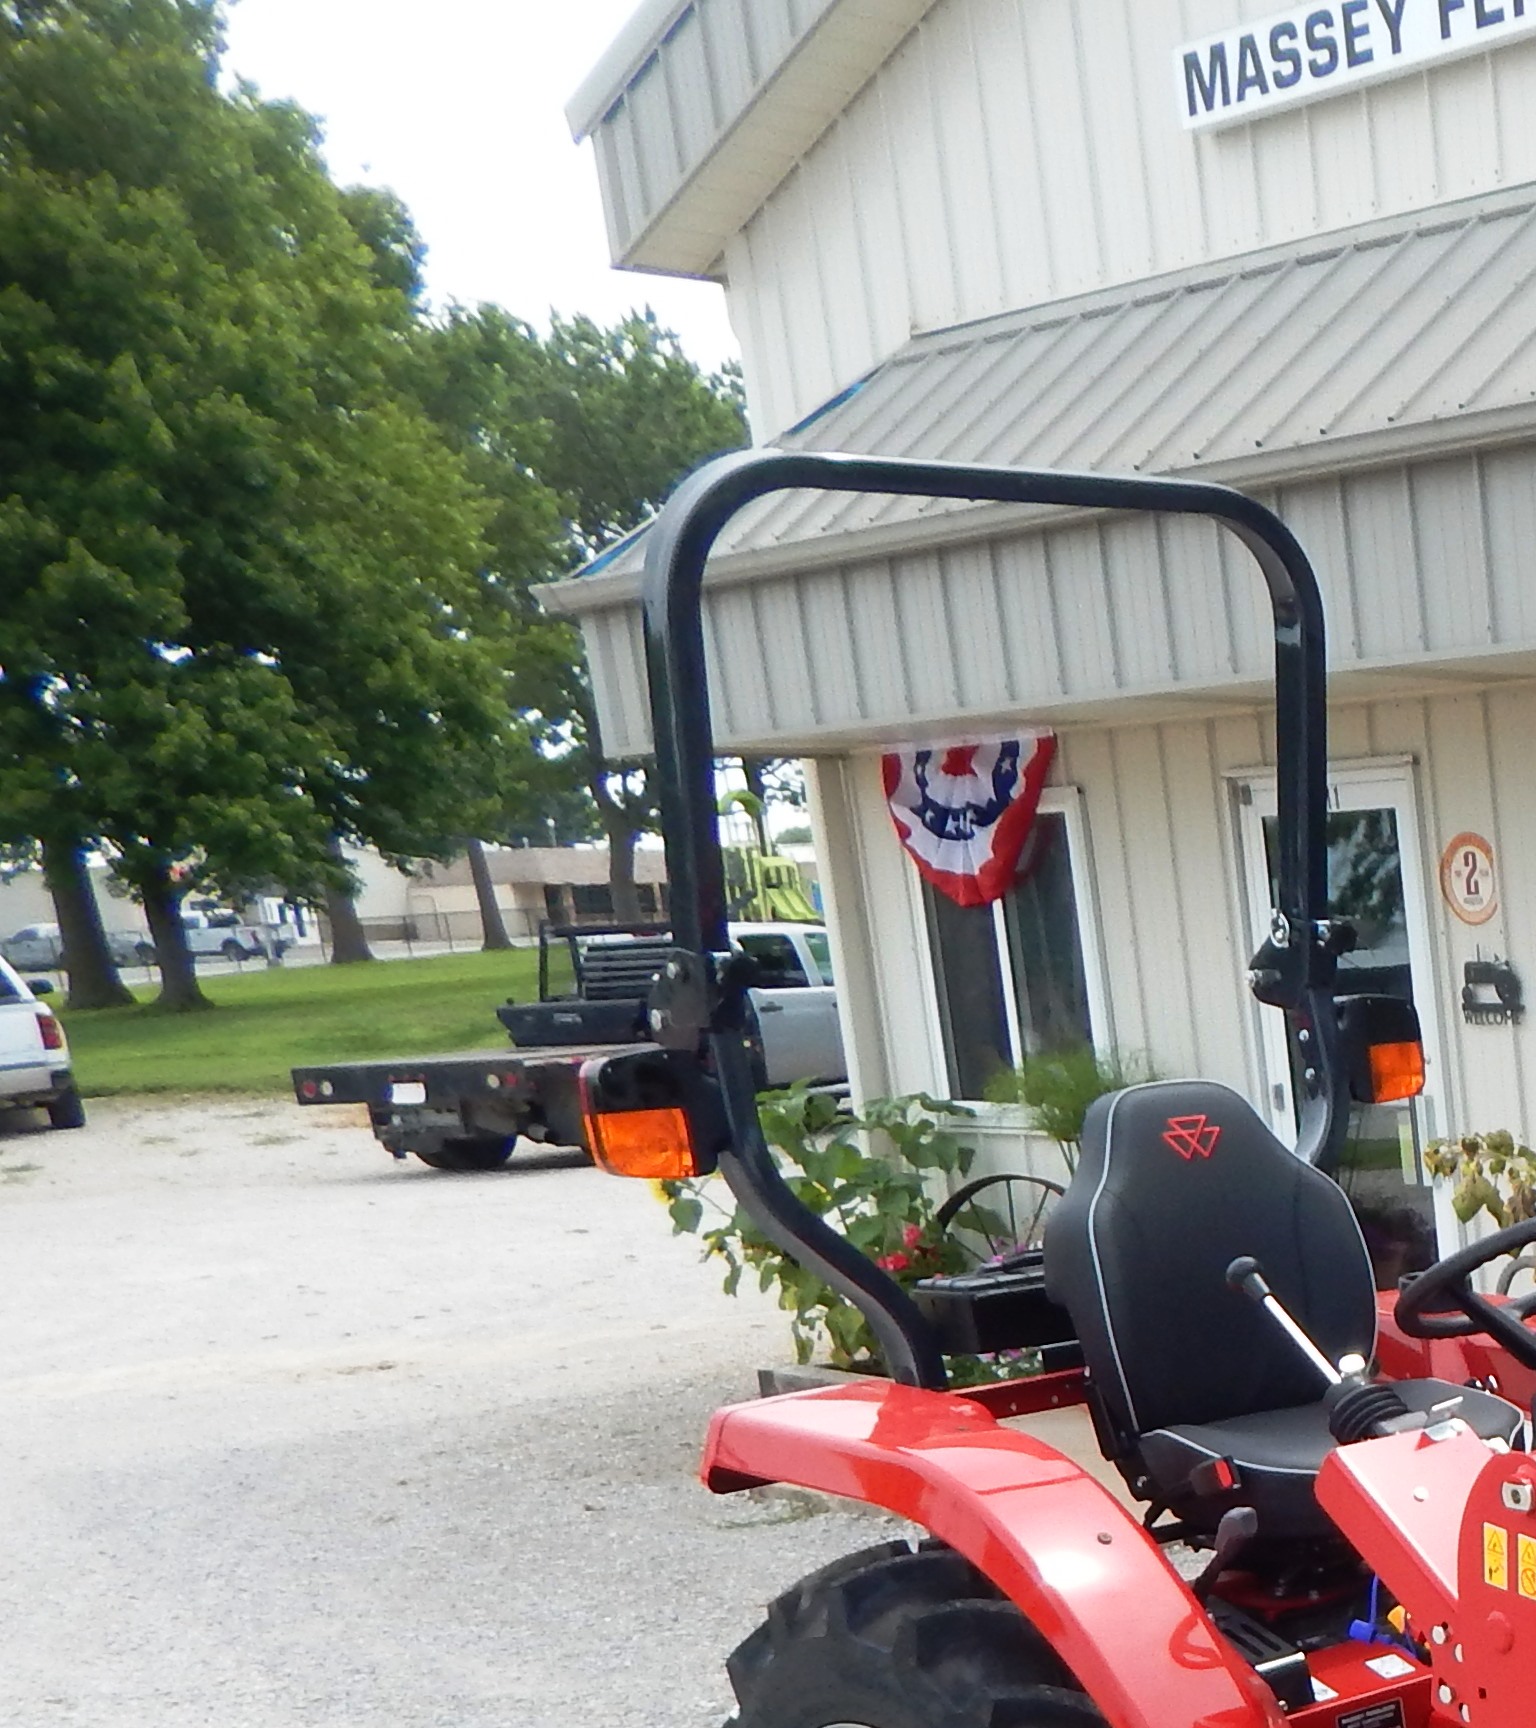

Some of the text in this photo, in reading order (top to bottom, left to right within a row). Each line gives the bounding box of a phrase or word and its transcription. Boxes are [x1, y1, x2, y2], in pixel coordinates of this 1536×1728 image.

[1182, 0, 1405, 117] MASSEY
[1463, 851, 1480, 896] 2
[1463, 1008, 1522, 1026] WELCOME
